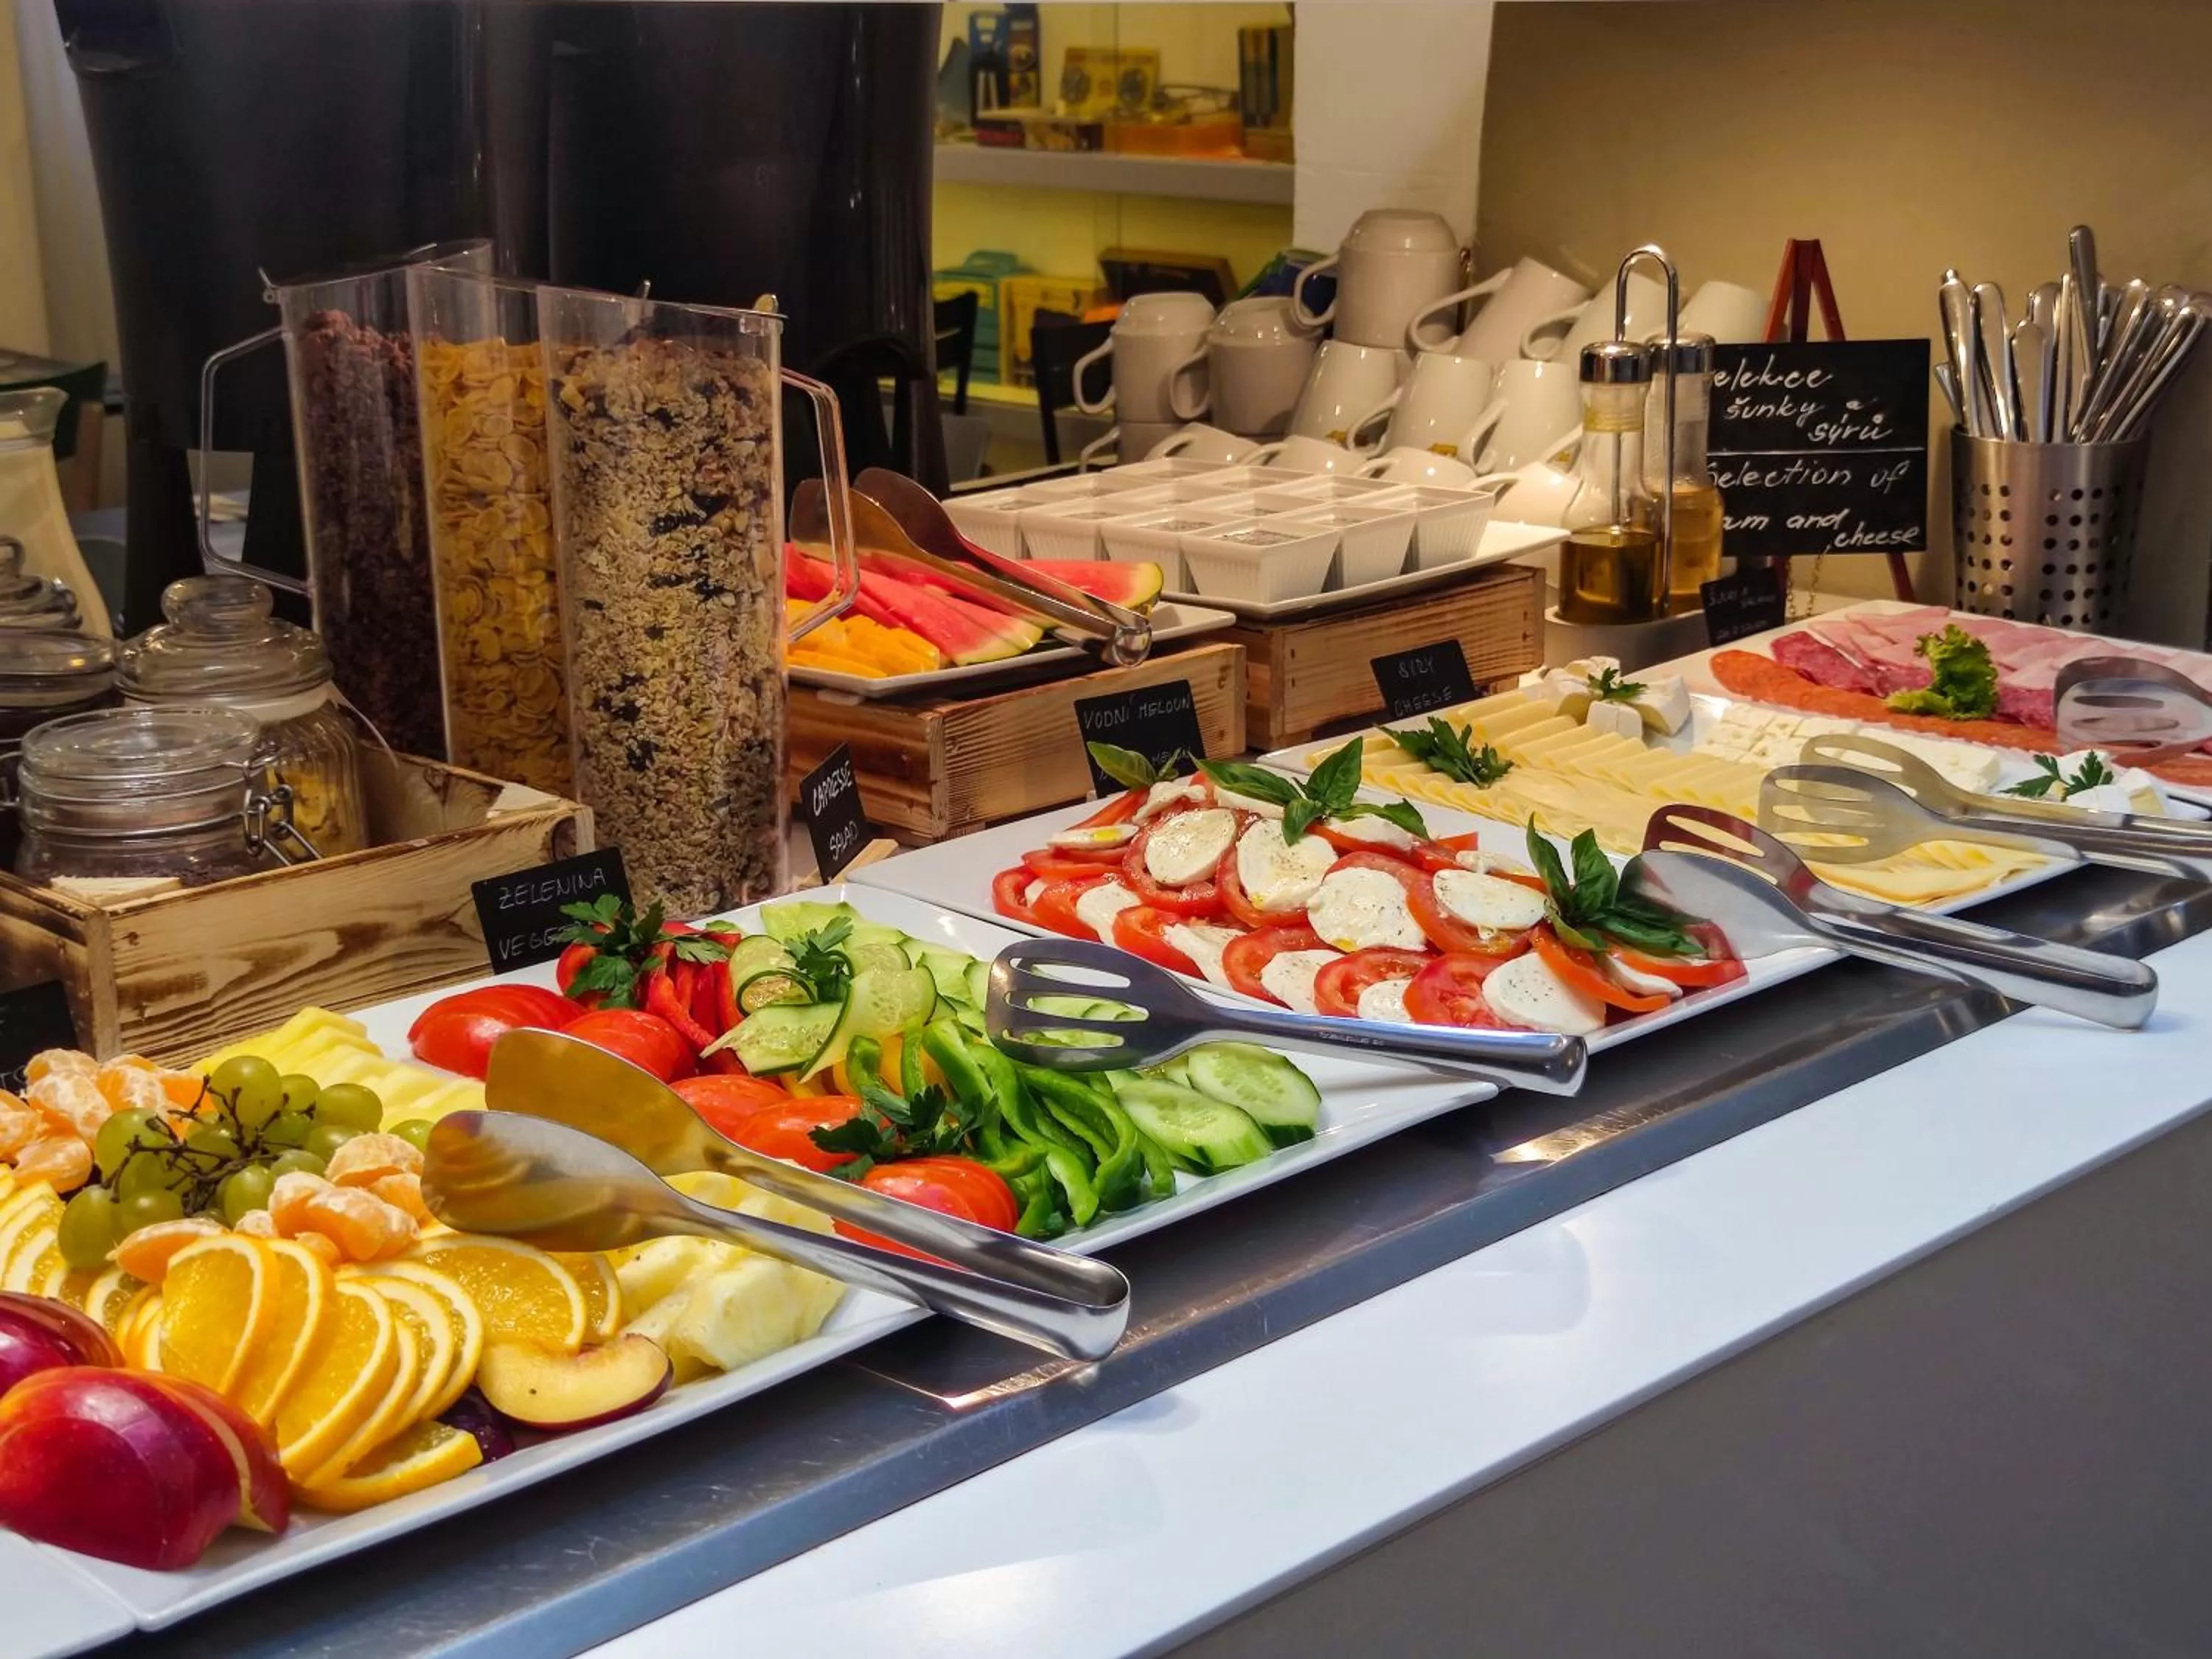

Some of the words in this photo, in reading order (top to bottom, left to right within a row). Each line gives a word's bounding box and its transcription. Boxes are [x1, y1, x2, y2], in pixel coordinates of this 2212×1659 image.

[1714, 353, 1833, 391] elekce
[1722, 394, 1826, 428] šunky
[1806, 413, 1893, 445] sýrů
[1870, 459, 1912, 494] of
[1785, 507, 1851, 531] and
[1833, 521, 1921, 549] cheese
[1394, 684, 1453, 717] CHEESE
